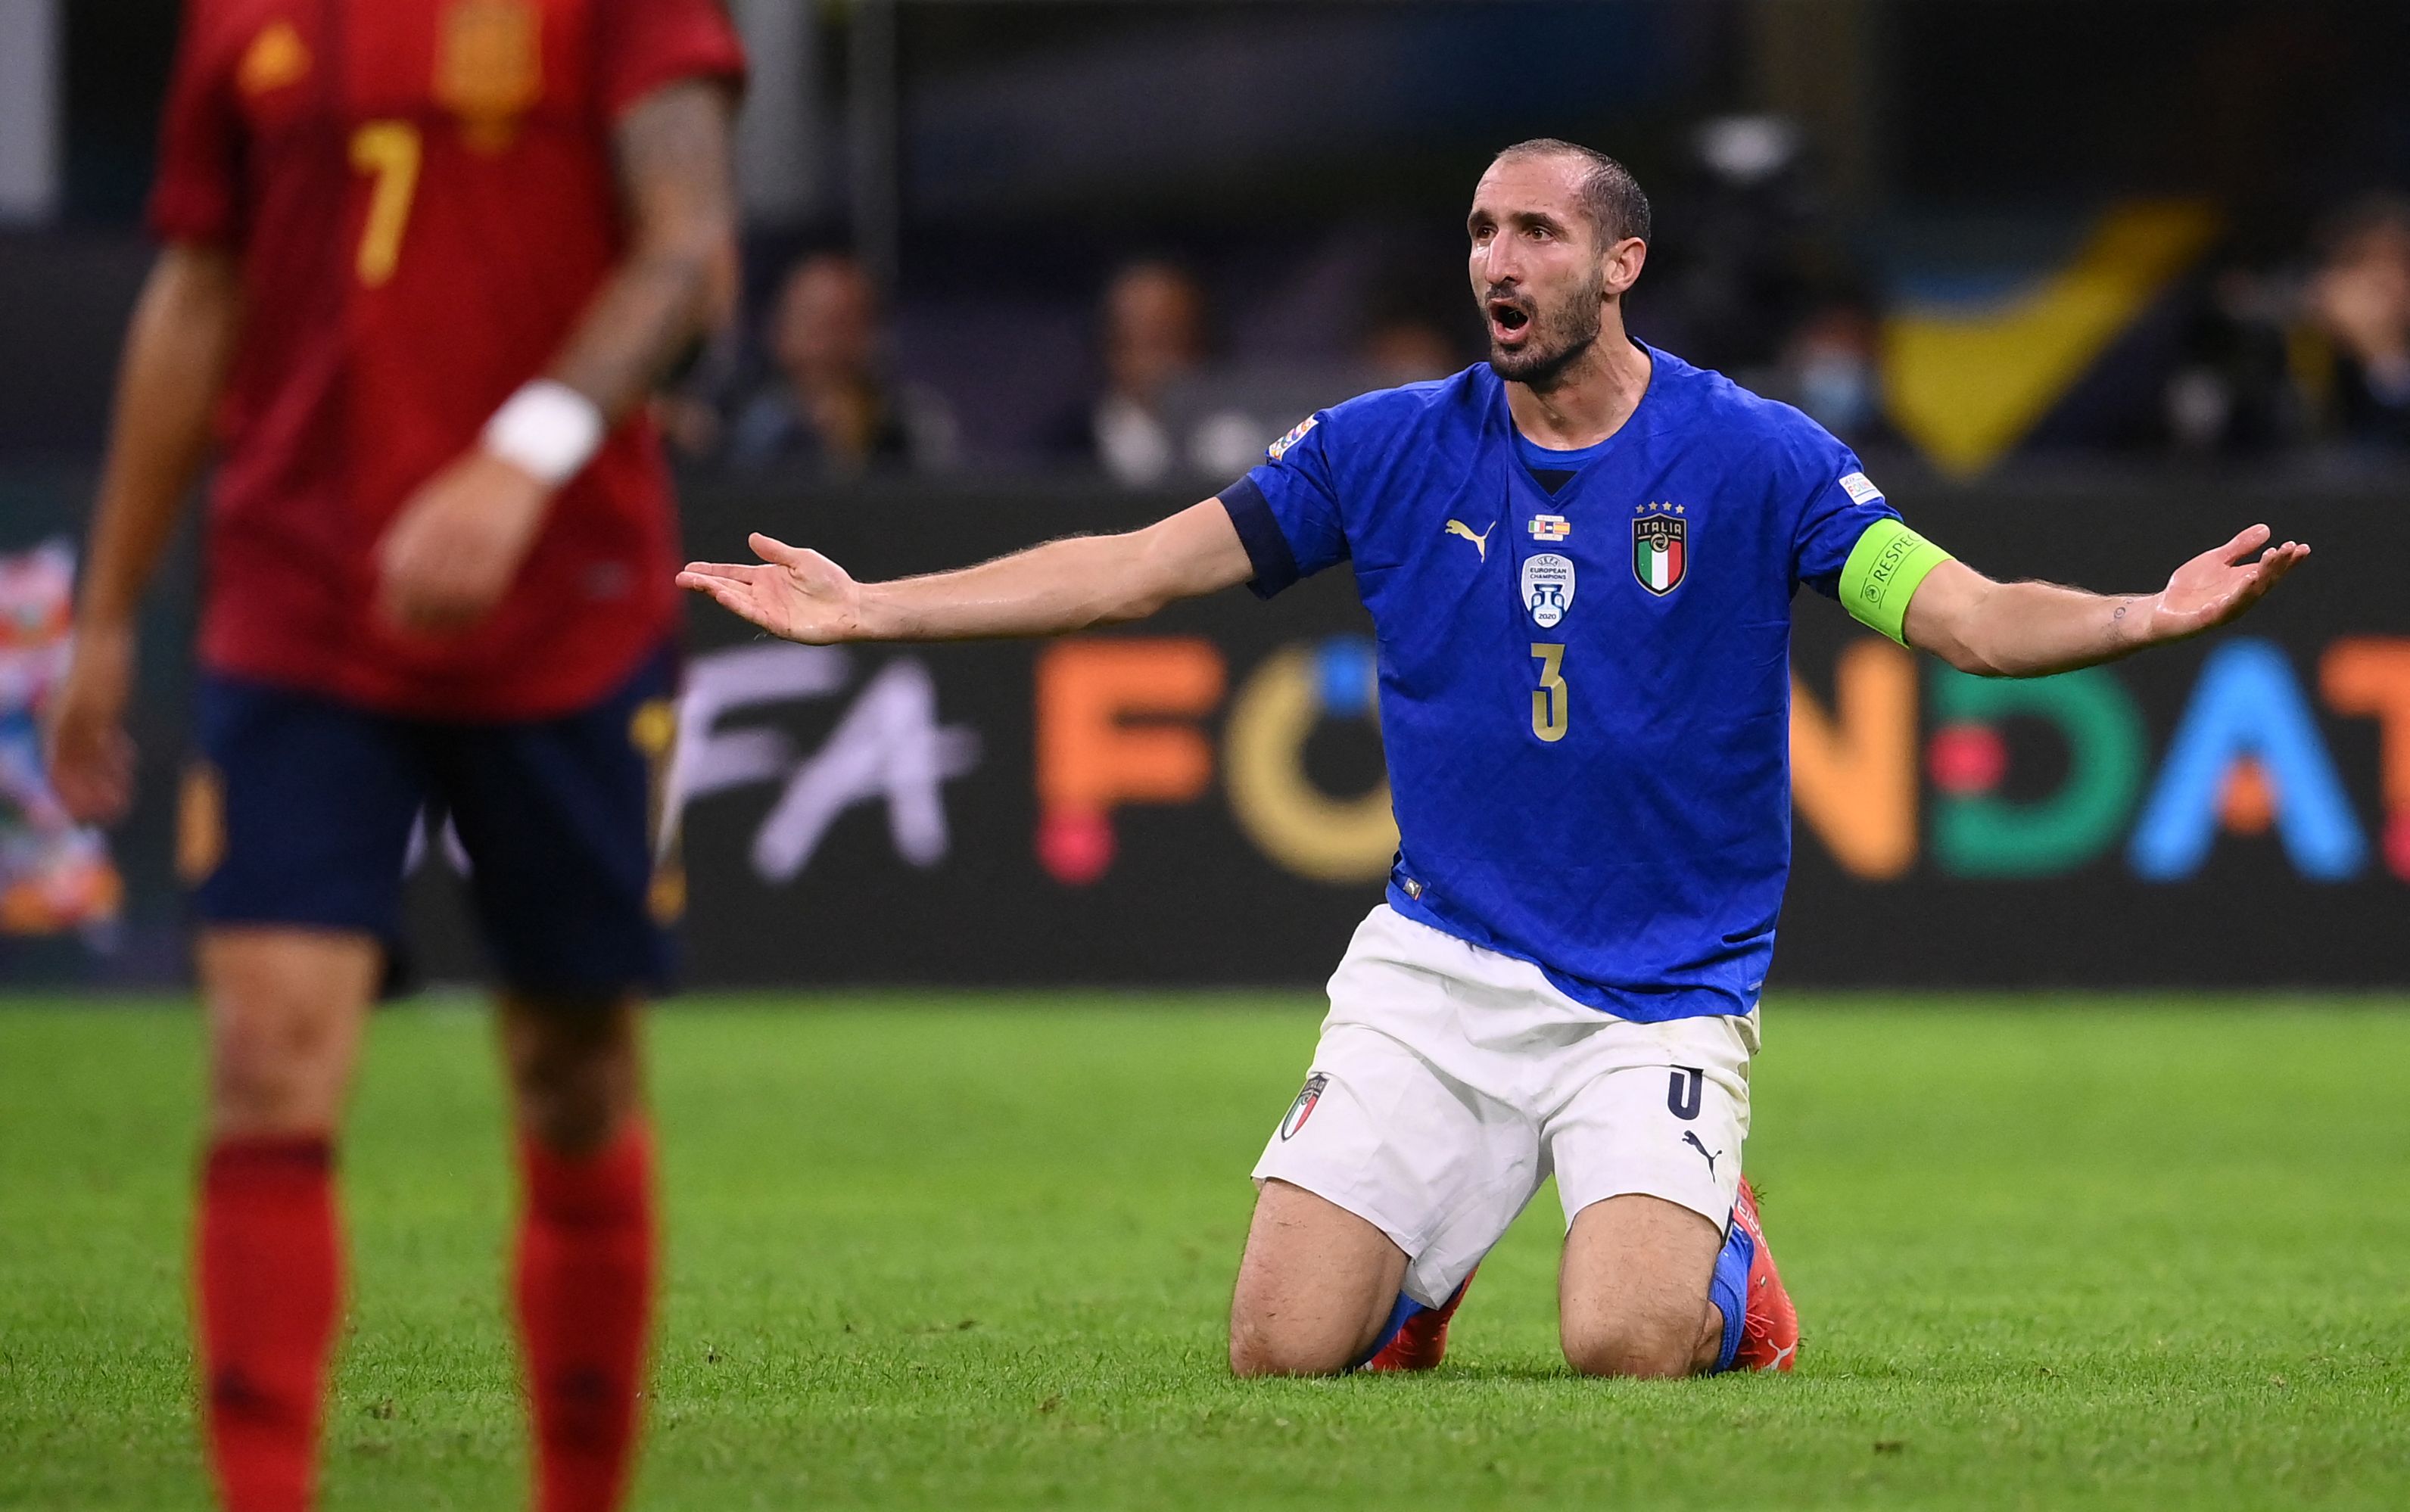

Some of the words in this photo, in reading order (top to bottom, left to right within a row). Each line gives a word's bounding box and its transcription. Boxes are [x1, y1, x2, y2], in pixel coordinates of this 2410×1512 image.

[347, 121, 422, 288] 7
[1537, 557, 1559, 567] UEFA
[1637, 521, 1682, 535] ITALIA
[1873, 533, 1920, 583] RESPEC
[1530, 642, 1568, 742] 3
[655, 643, 984, 882] FA
